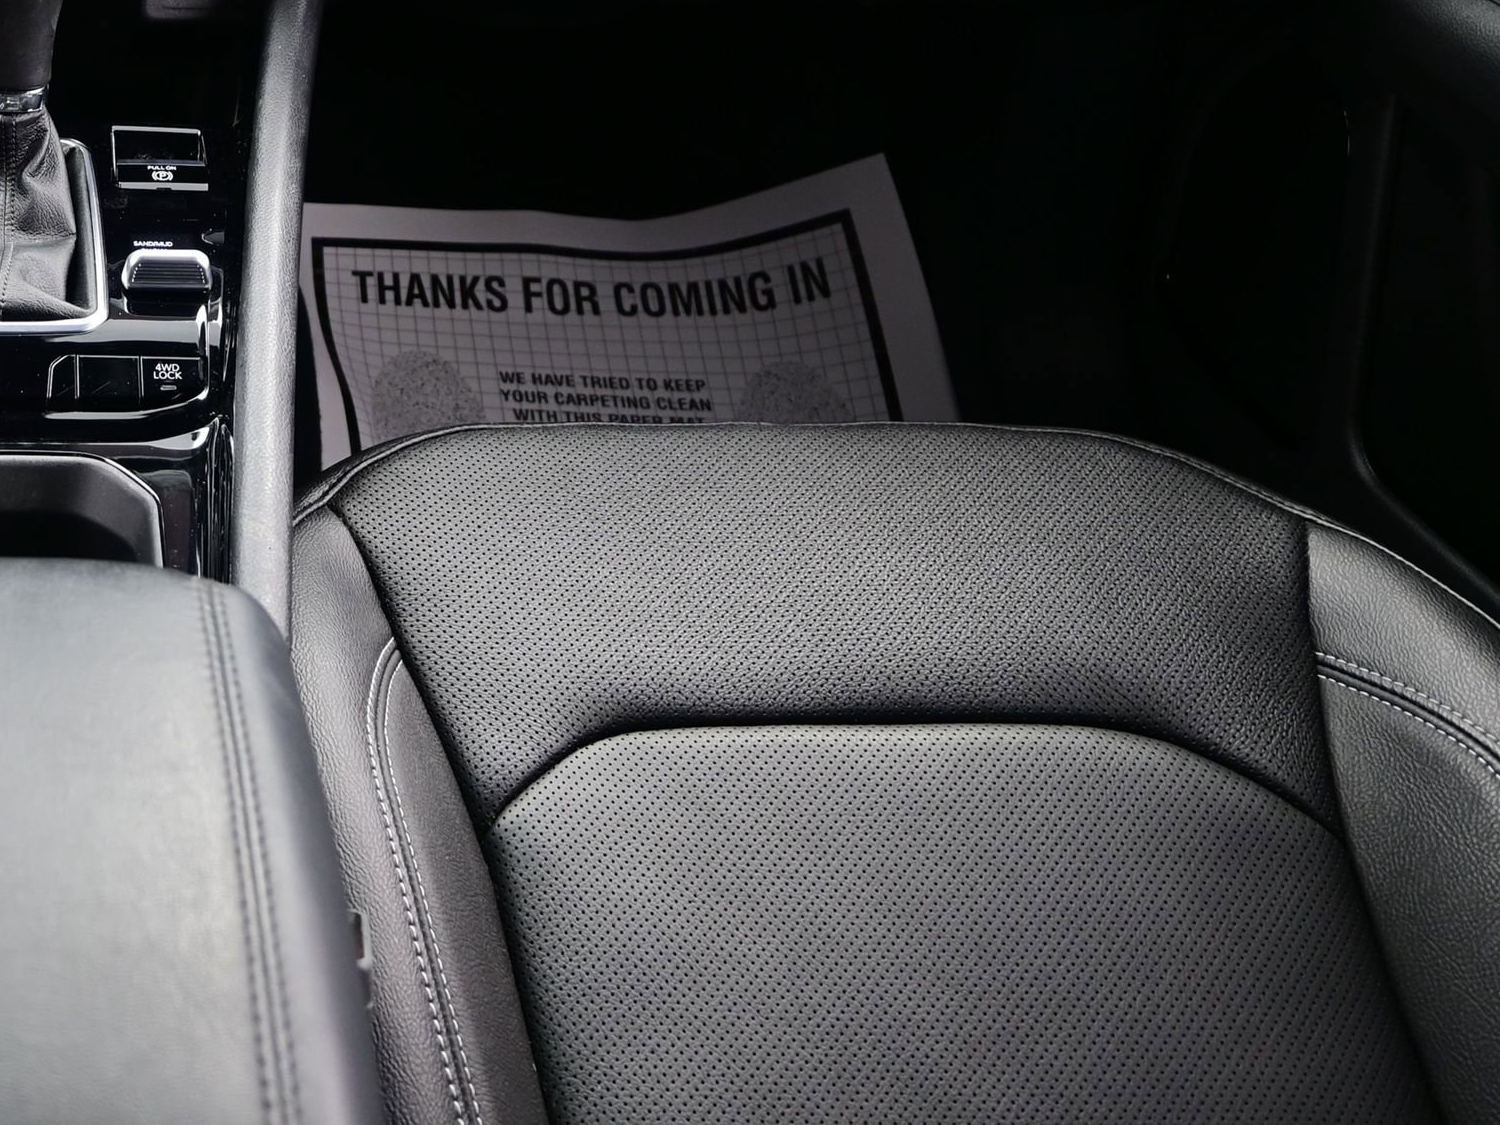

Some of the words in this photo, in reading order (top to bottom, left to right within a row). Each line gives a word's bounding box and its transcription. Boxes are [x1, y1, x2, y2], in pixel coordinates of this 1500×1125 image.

[351, 270, 509, 313] THANKS
[522, 277, 601, 316] FOR
[613, 270, 777, 318] COMING
[786, 257, 832, 306] IN
[153, 371, 183, 380] LOCK
[155, 363, 180, 372] 4WD
[499, 371, 526, 385] WE
[531, 372, 576, 388] HAVE
[580, 375, 631, 391] TRIED
[635, 377, 658, 392] TO
[663, 378, 707, 393] KEEP
[499, 388, 550, 405] YOUR
[553, 391, 651, 410] CARPETING
[655, 396, 713, 412] CLEAN
[512, 408, 559, 423] WITH
[563, 411, 604, 424] THIS
